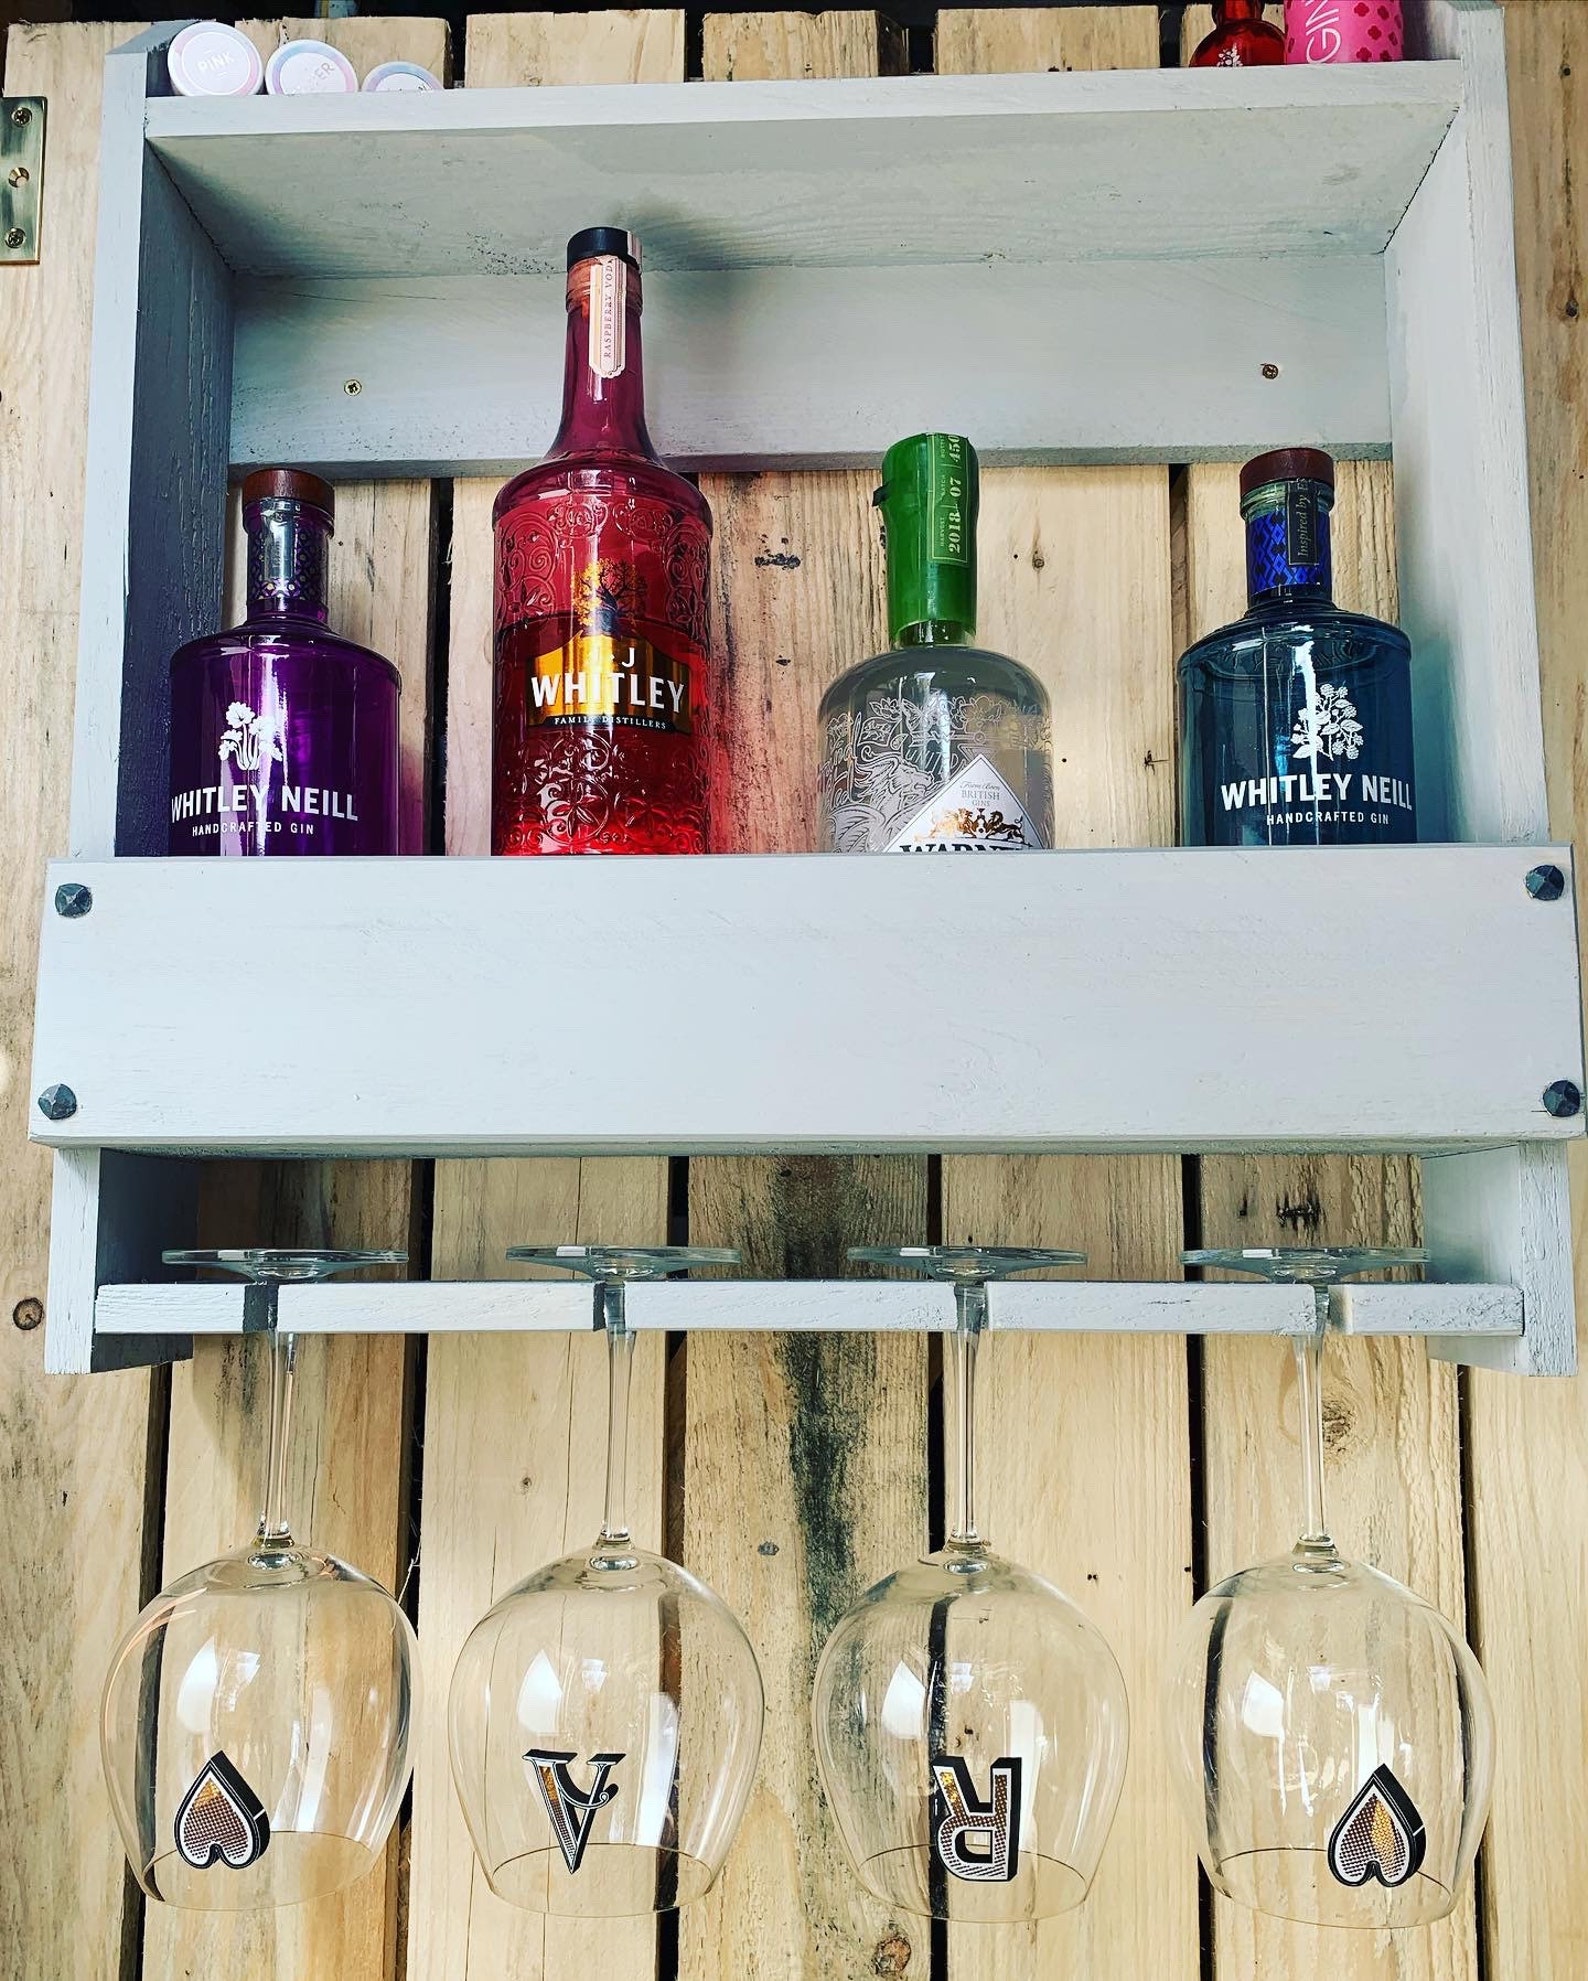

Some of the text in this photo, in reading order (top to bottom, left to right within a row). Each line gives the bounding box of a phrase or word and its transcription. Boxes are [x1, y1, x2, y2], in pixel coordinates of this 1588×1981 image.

[196, 52, 234, 73] PINK
[604, 296, 613, 358] RASPBERRY
[949, 477, 962, 498] 07
[1296, 495, 1310, 509] by
[948, 512, 961, 553] 2018
[1296, 512, 1311, 557] Inspired
[531, 673, 685, 713] WHITLEY
[602, 715, 666, 730] DISTILLERS
[171, 784, 358, 823] WHITLEY NEILL
[961, 790, 1000, 801] BRITISH
[1220, 773, 1413, 811] WHITLEY NEILL
[192, 821, 314, 837] HANDCRAFTED GIN
[1266, 811, 1389, 826] HANDCRAFTED GIN
[932, 1756, 1023, 1882] R
